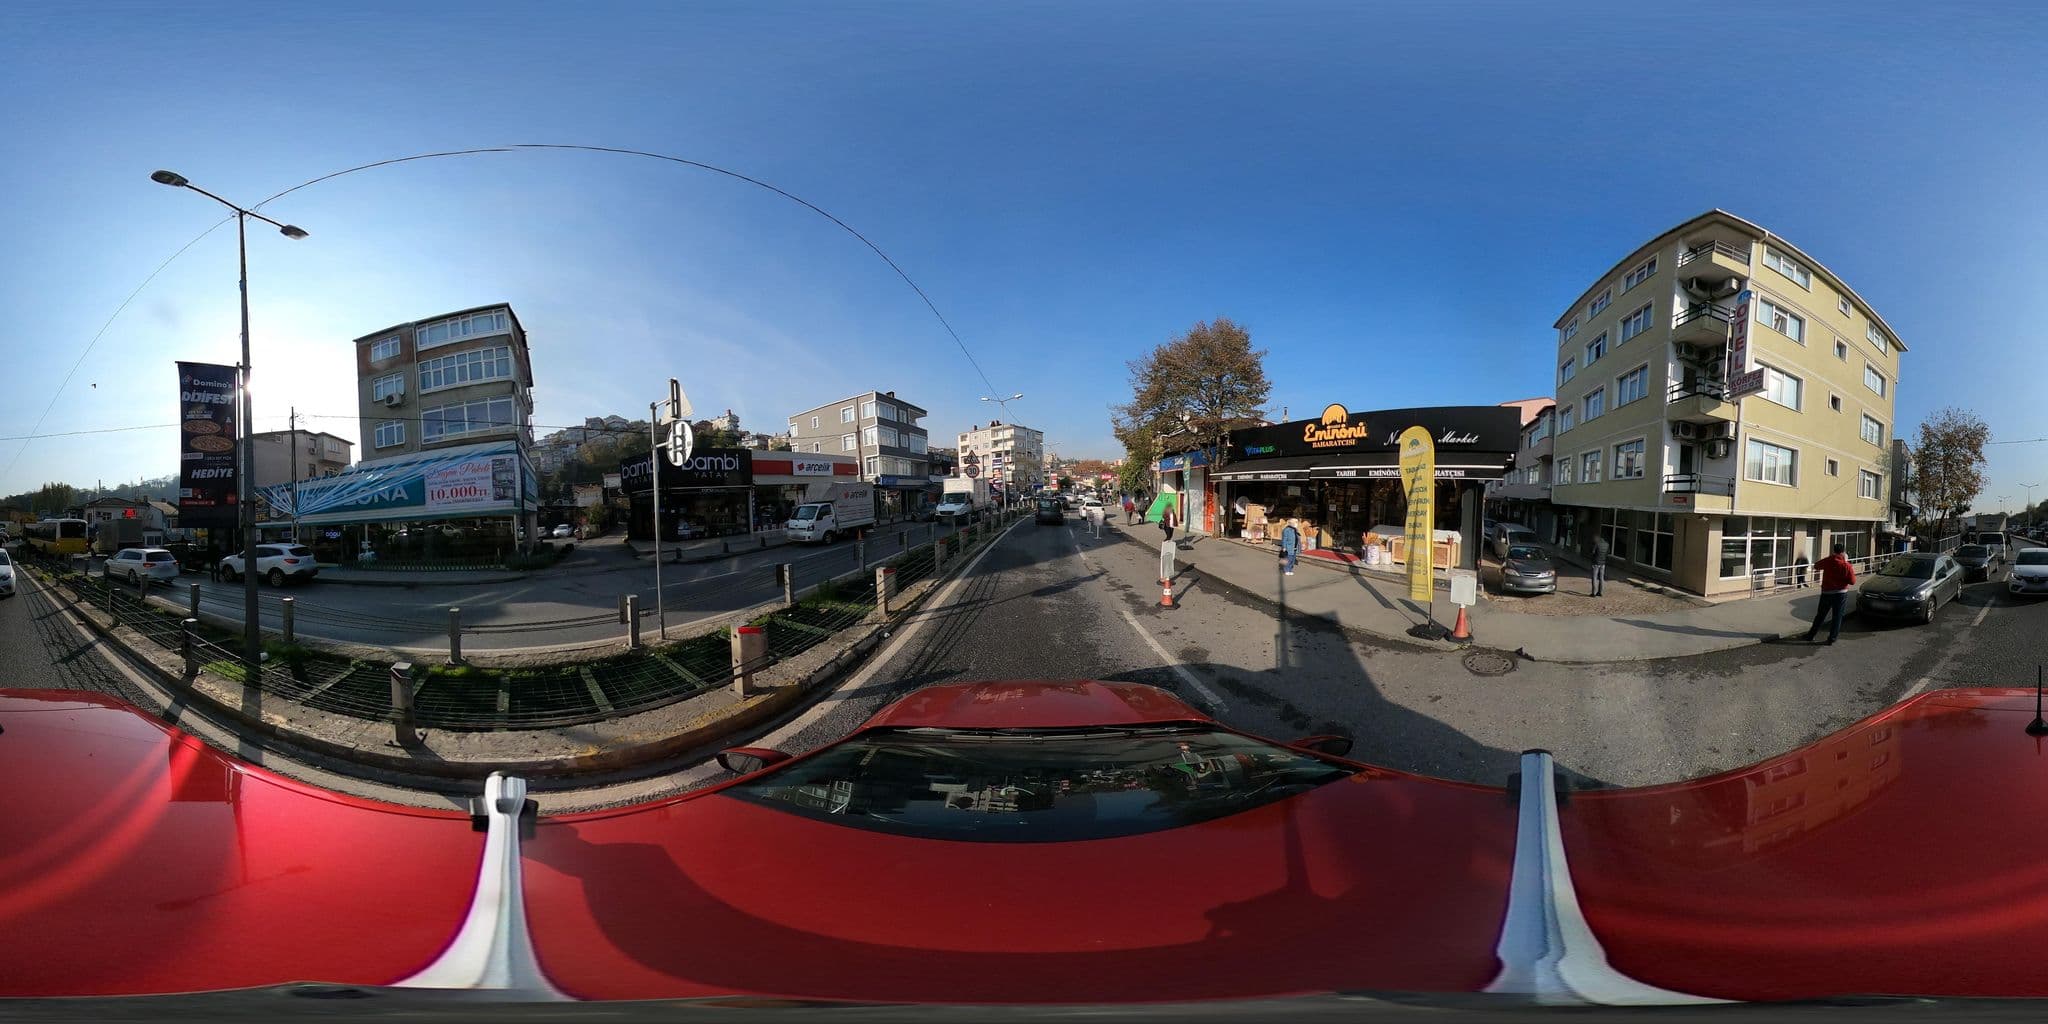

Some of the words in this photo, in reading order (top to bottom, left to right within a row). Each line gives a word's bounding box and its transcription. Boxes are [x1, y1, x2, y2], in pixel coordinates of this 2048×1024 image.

[1734, 303, 1748, 370] OTEL
[193, 379, 232, 389] Domino's
[1438, 431, 1479, 444] Market
[191, 466, 234, 479] HEDİYE
[805, 462, 831, 474] arçelik
[968, 467, 977, 475] 30
[694, 471, 729, 479] YATAK
